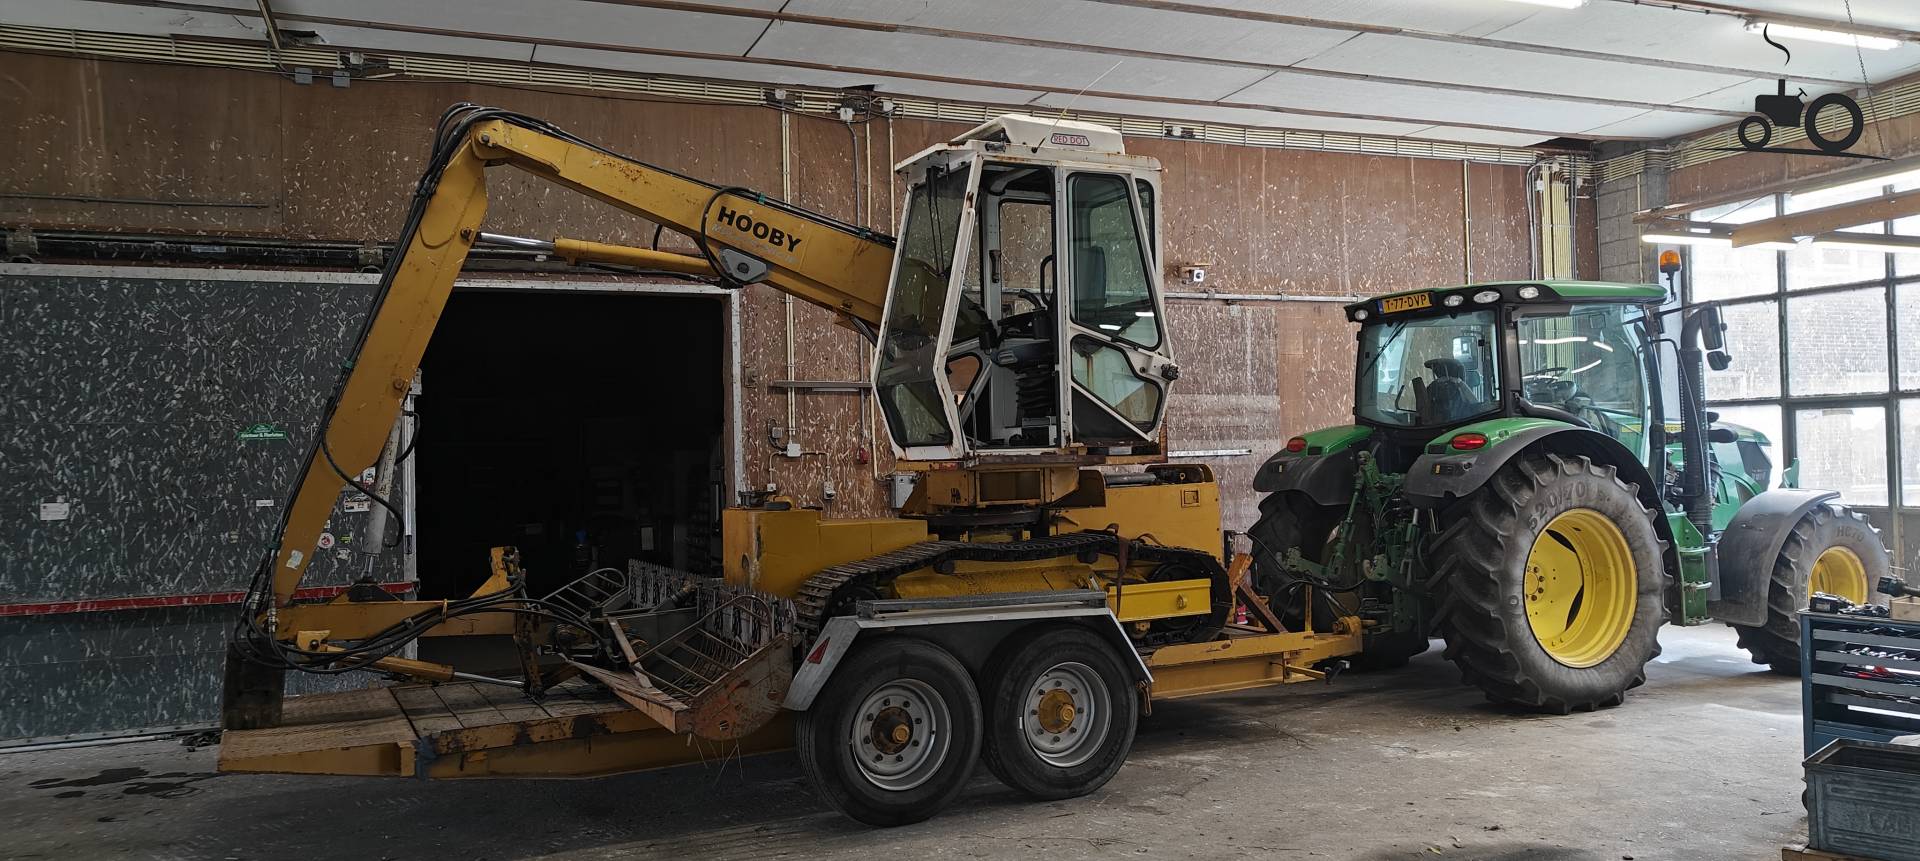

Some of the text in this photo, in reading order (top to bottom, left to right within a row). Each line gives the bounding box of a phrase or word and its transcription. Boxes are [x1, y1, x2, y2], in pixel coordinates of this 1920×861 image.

[1054, 135, 1087, 145] RED DOT
[717, 206, 802, 253] HOOBY
[1385, 294, 1427, 310] T-77-DVP
